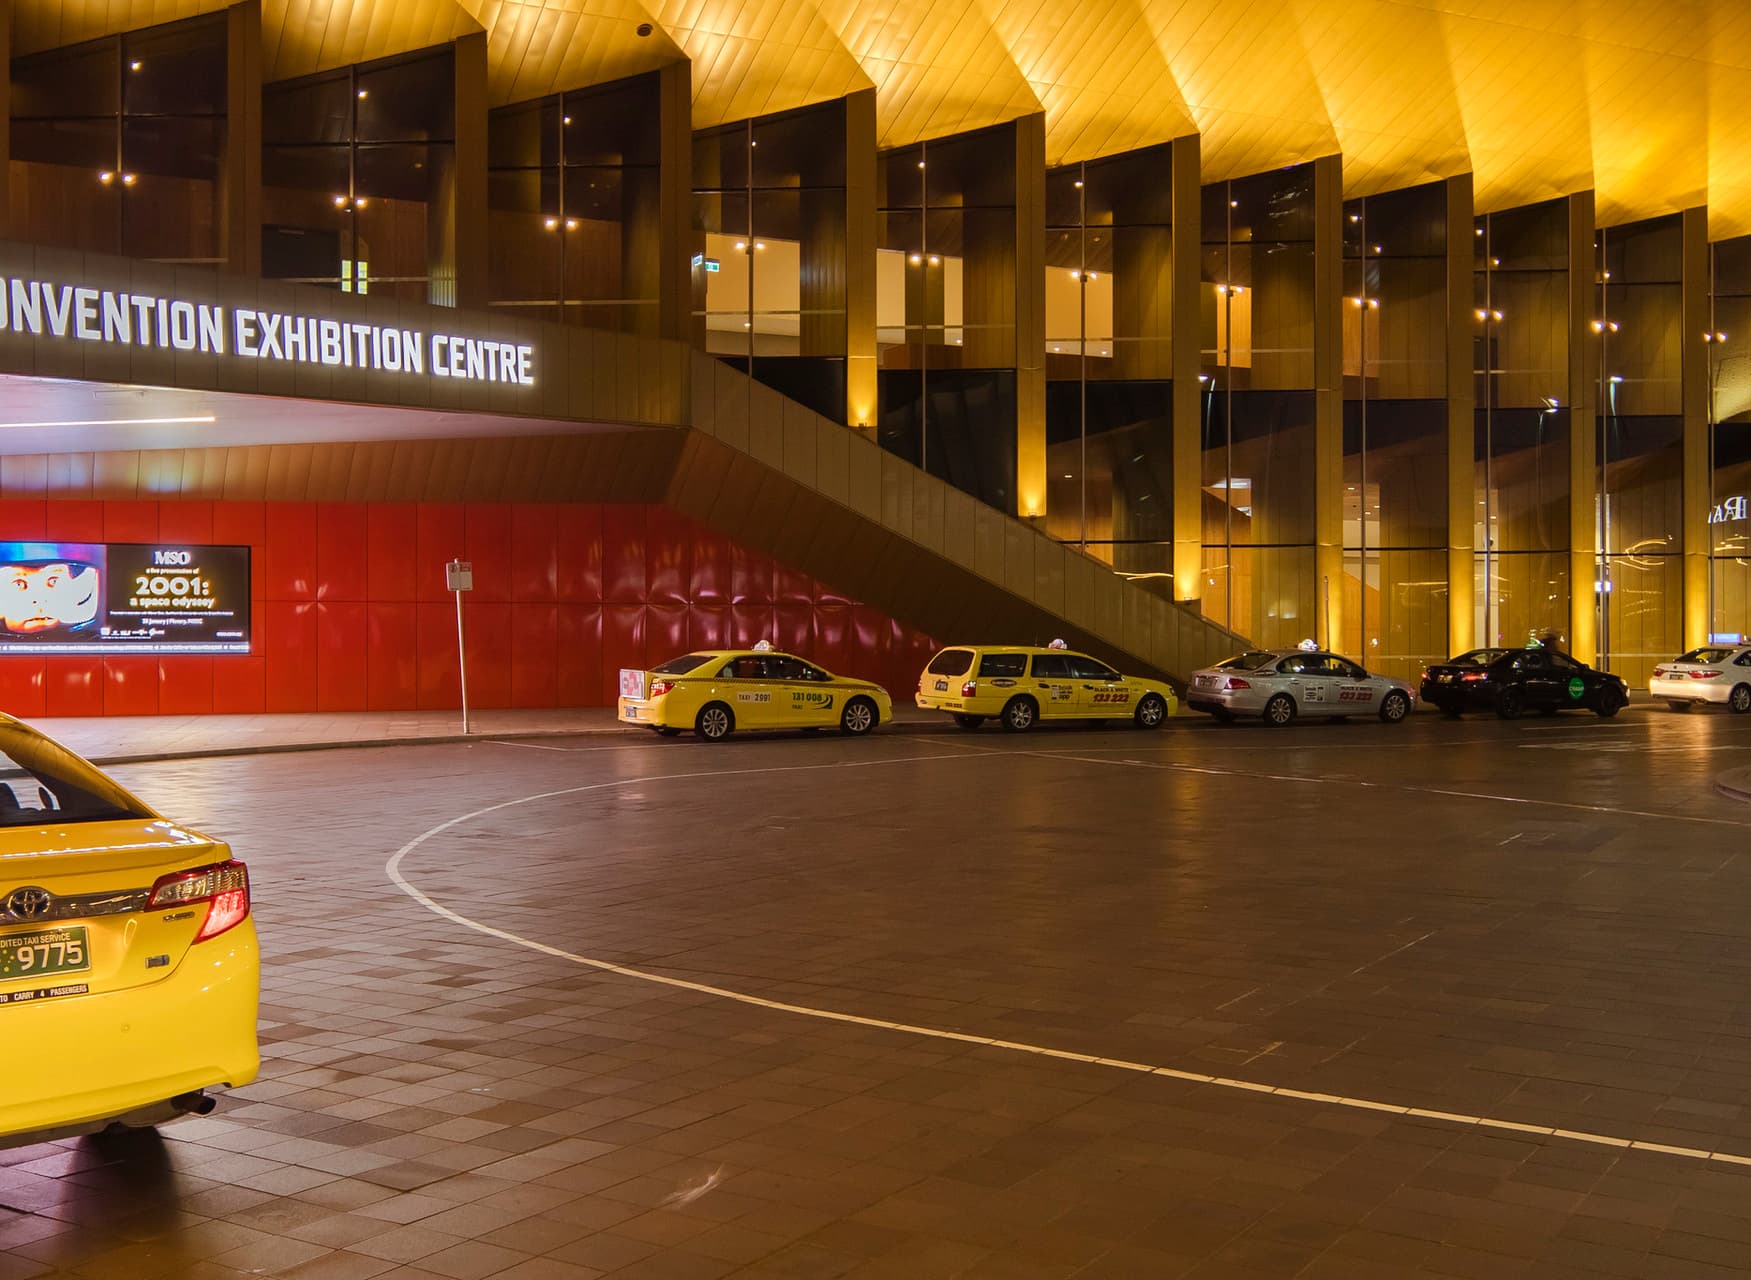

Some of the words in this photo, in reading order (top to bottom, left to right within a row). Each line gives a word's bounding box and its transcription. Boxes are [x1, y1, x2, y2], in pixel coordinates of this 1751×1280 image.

[0, 277, 223, 354] NVENTION
[236, 309, 423, 373] EXHIBITION
[432, 334, 535, 385] CENTRE
[154, 551, 191, 565] MSO
[135, 576, 209, 596] 2001:
[129, 598, 138, 606] a
[139, 598, 170, 609] space
[172, 596, 215, 609] odyssey
[754, 693, 771, 702] 2991
[23, 937, 40, 945] TAXI
[40, 932, 71, 943] SERVICE
[17, 940, 83, 971] 9775
[14, 991, 35, 1001] CARRY
[50, 984, 87, 996] PASSENGERS
